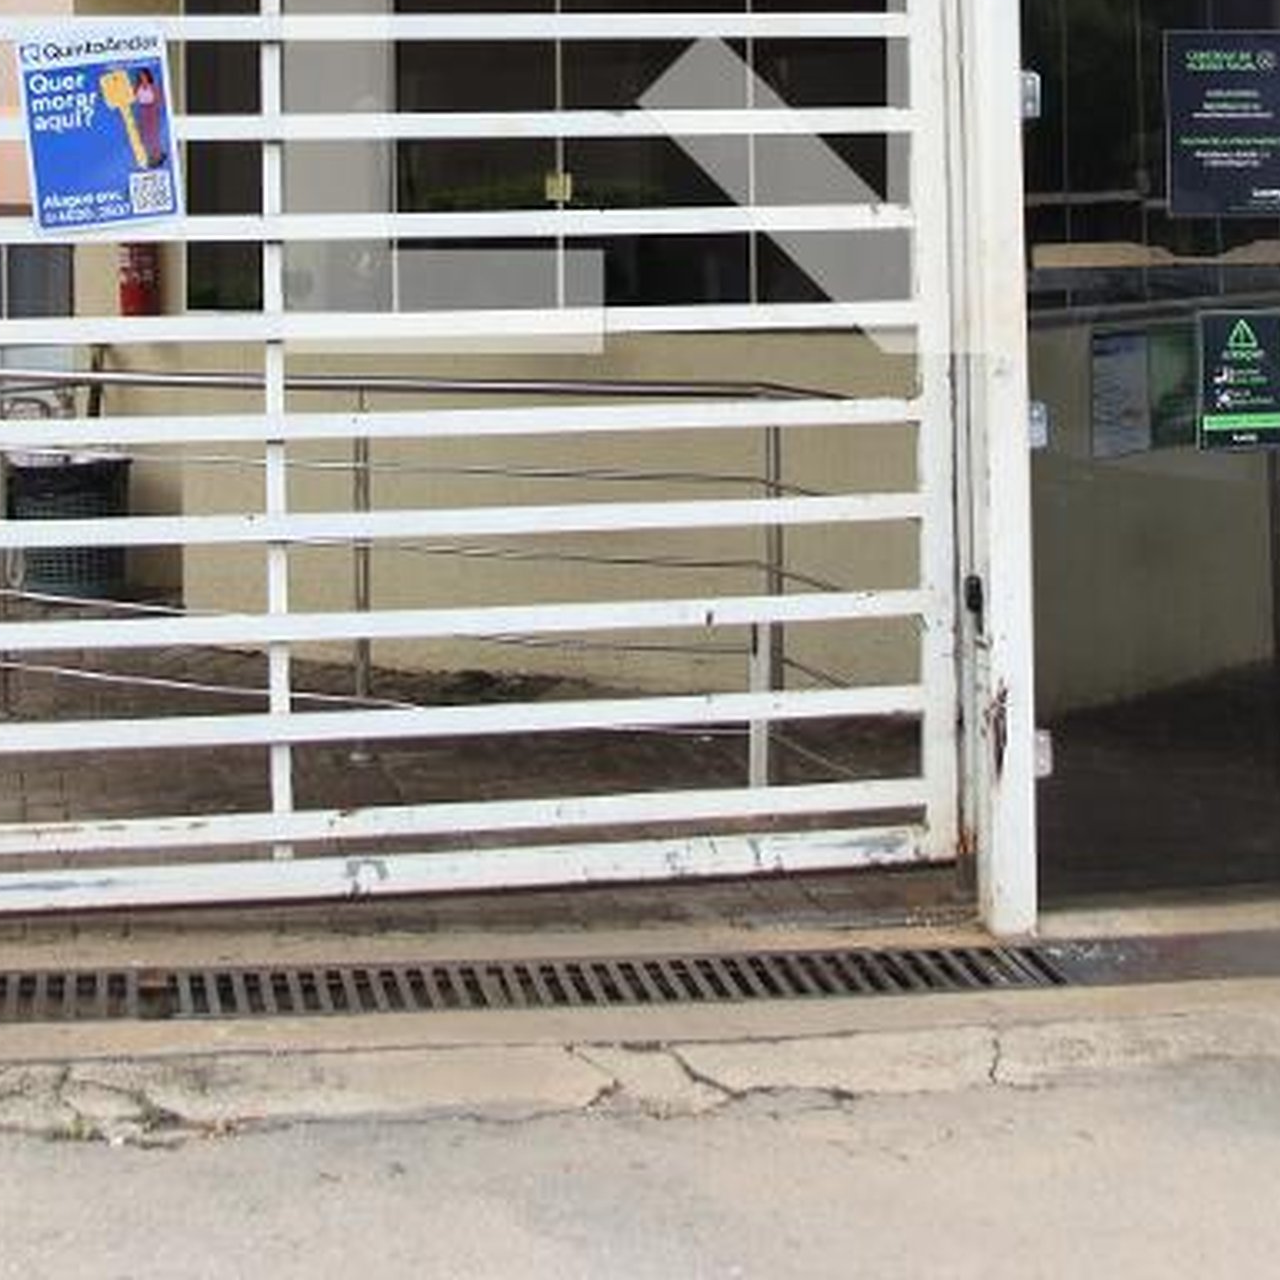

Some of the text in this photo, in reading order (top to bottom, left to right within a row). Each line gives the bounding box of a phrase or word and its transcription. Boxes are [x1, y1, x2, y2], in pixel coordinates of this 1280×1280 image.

[29, 73, 87, 94] Quer
[31, 91, 98, 113] morar
[33, 106, 95, 133] aqui?
